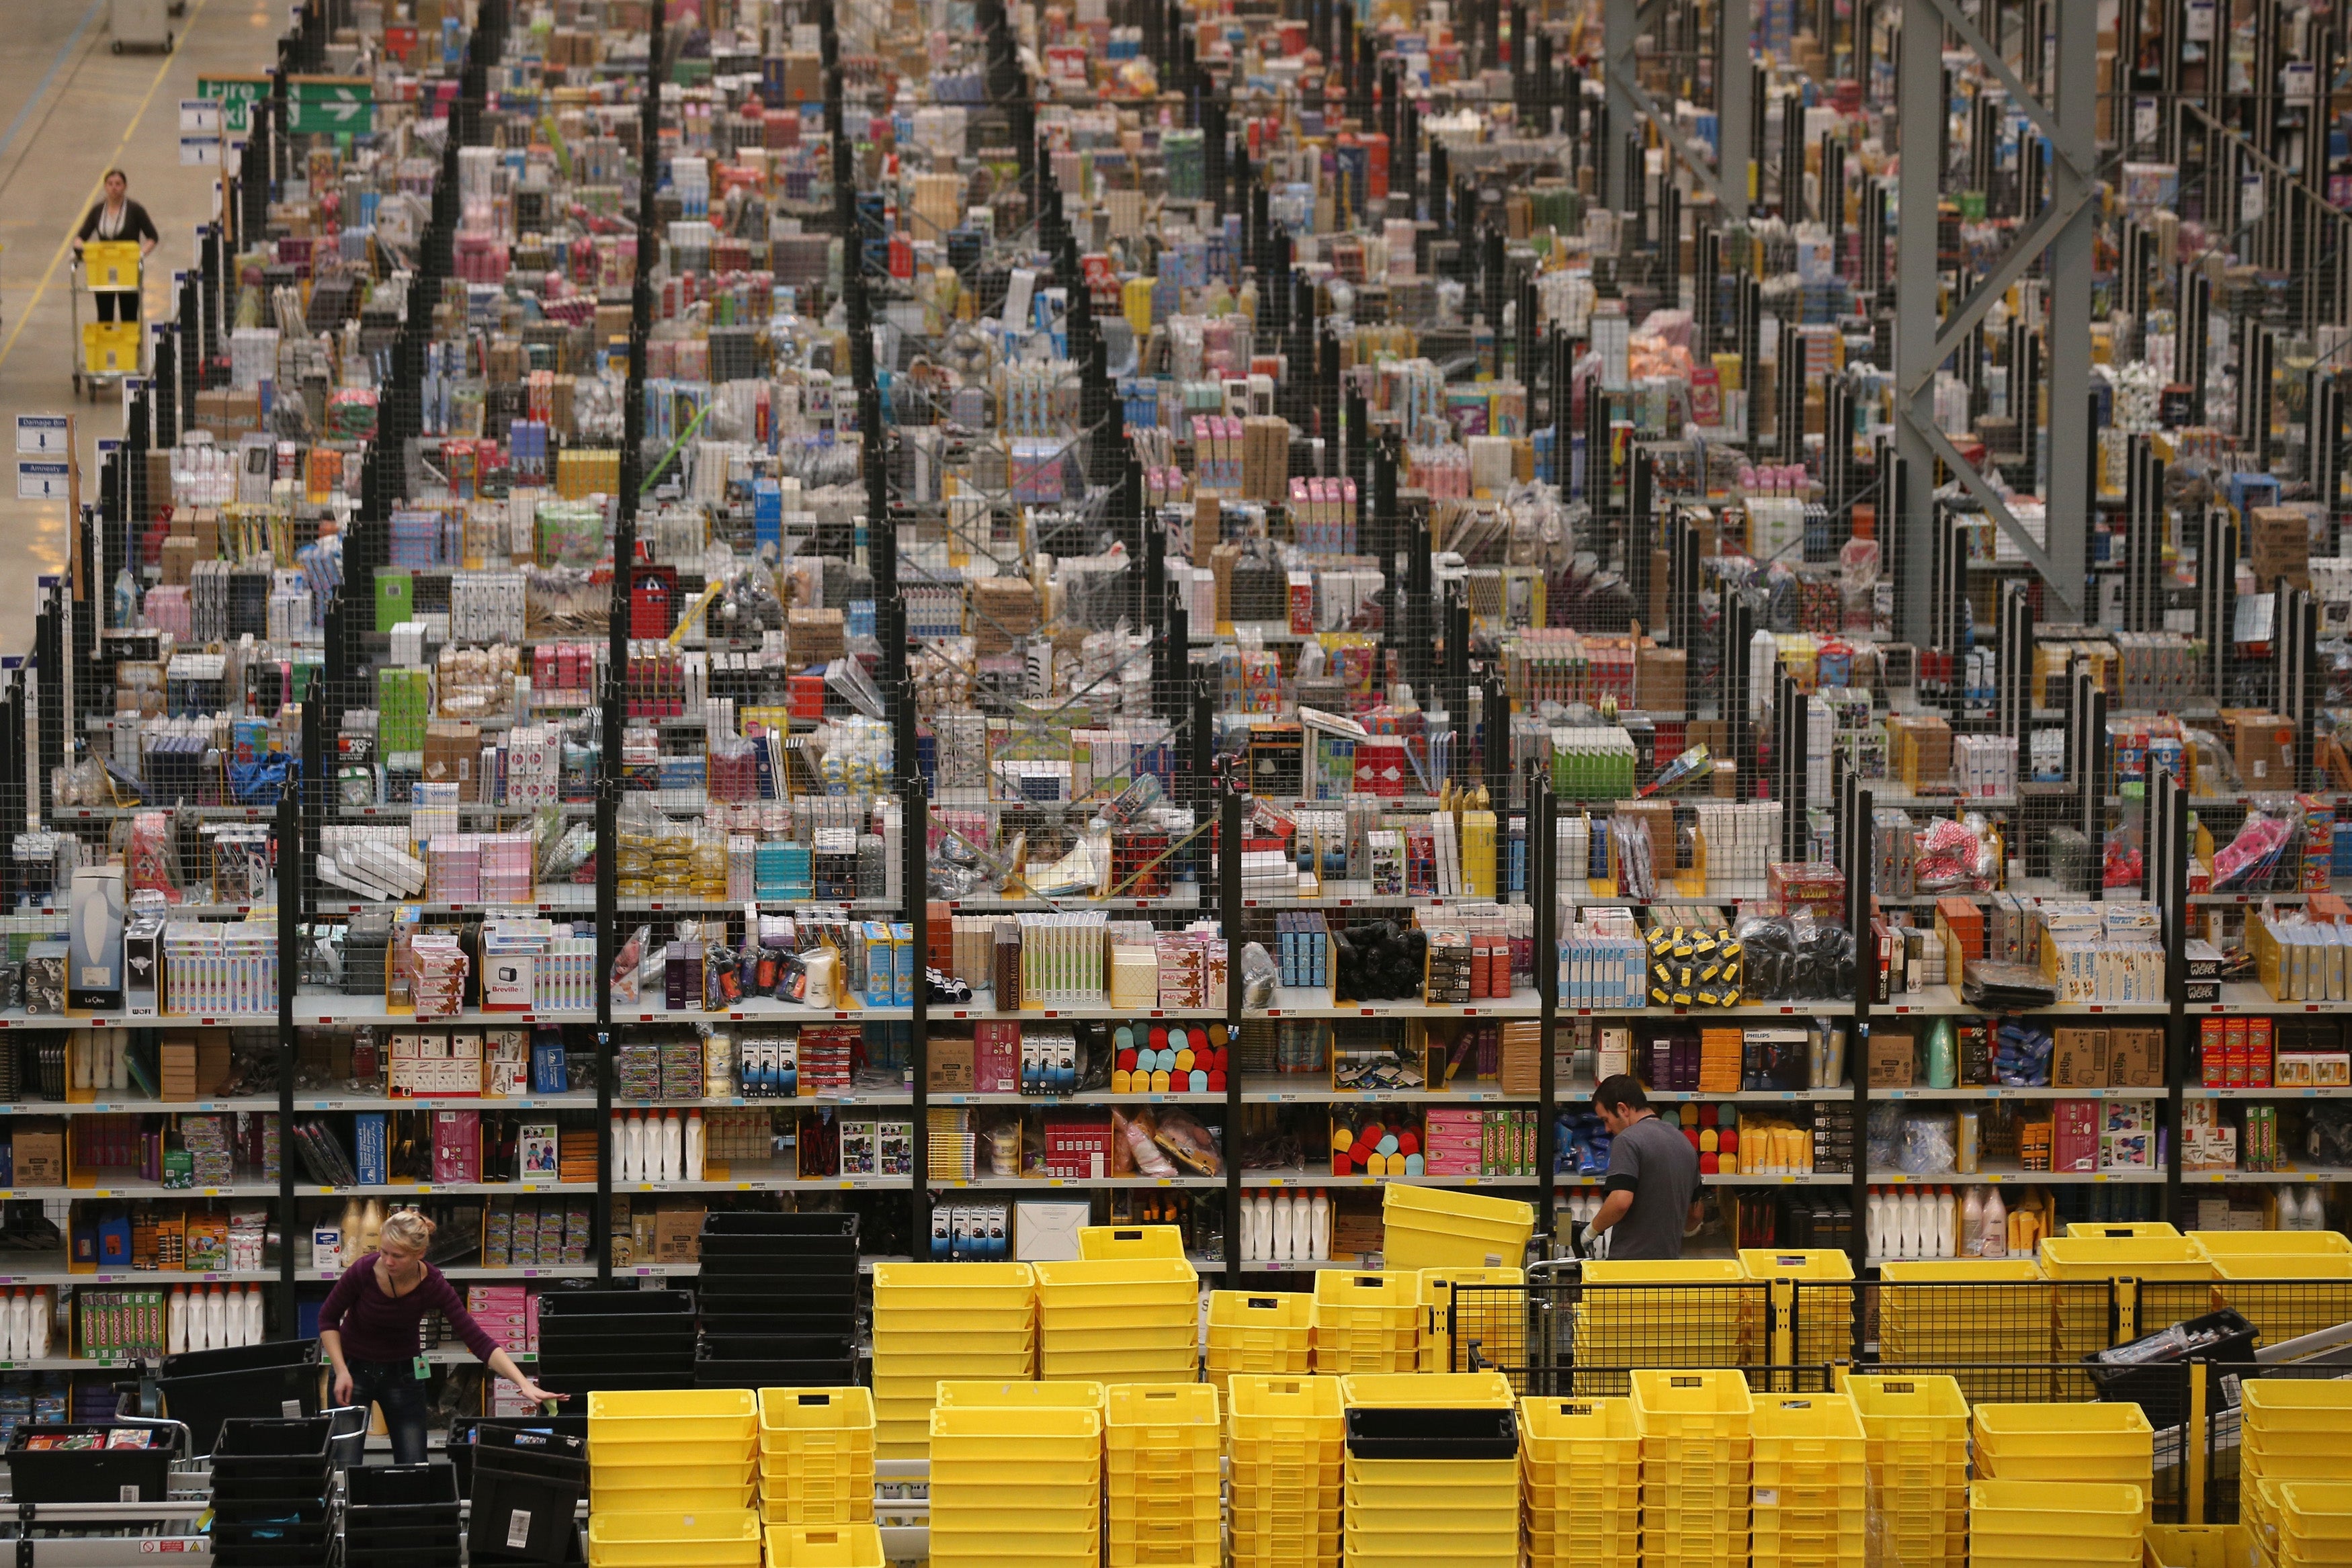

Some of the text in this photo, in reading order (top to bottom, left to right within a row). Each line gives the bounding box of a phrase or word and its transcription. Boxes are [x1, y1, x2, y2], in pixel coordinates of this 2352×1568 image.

[206, 81, 255, 99] Fire
[23, 417, 51, 427] Damage
[30, 465, 60, 474] Amnesty
[1010, 945, 1018, 979] HARDING
[85, 996, 91, 1004] La
[1010, 986, 1018, 1010] BAYLIS
